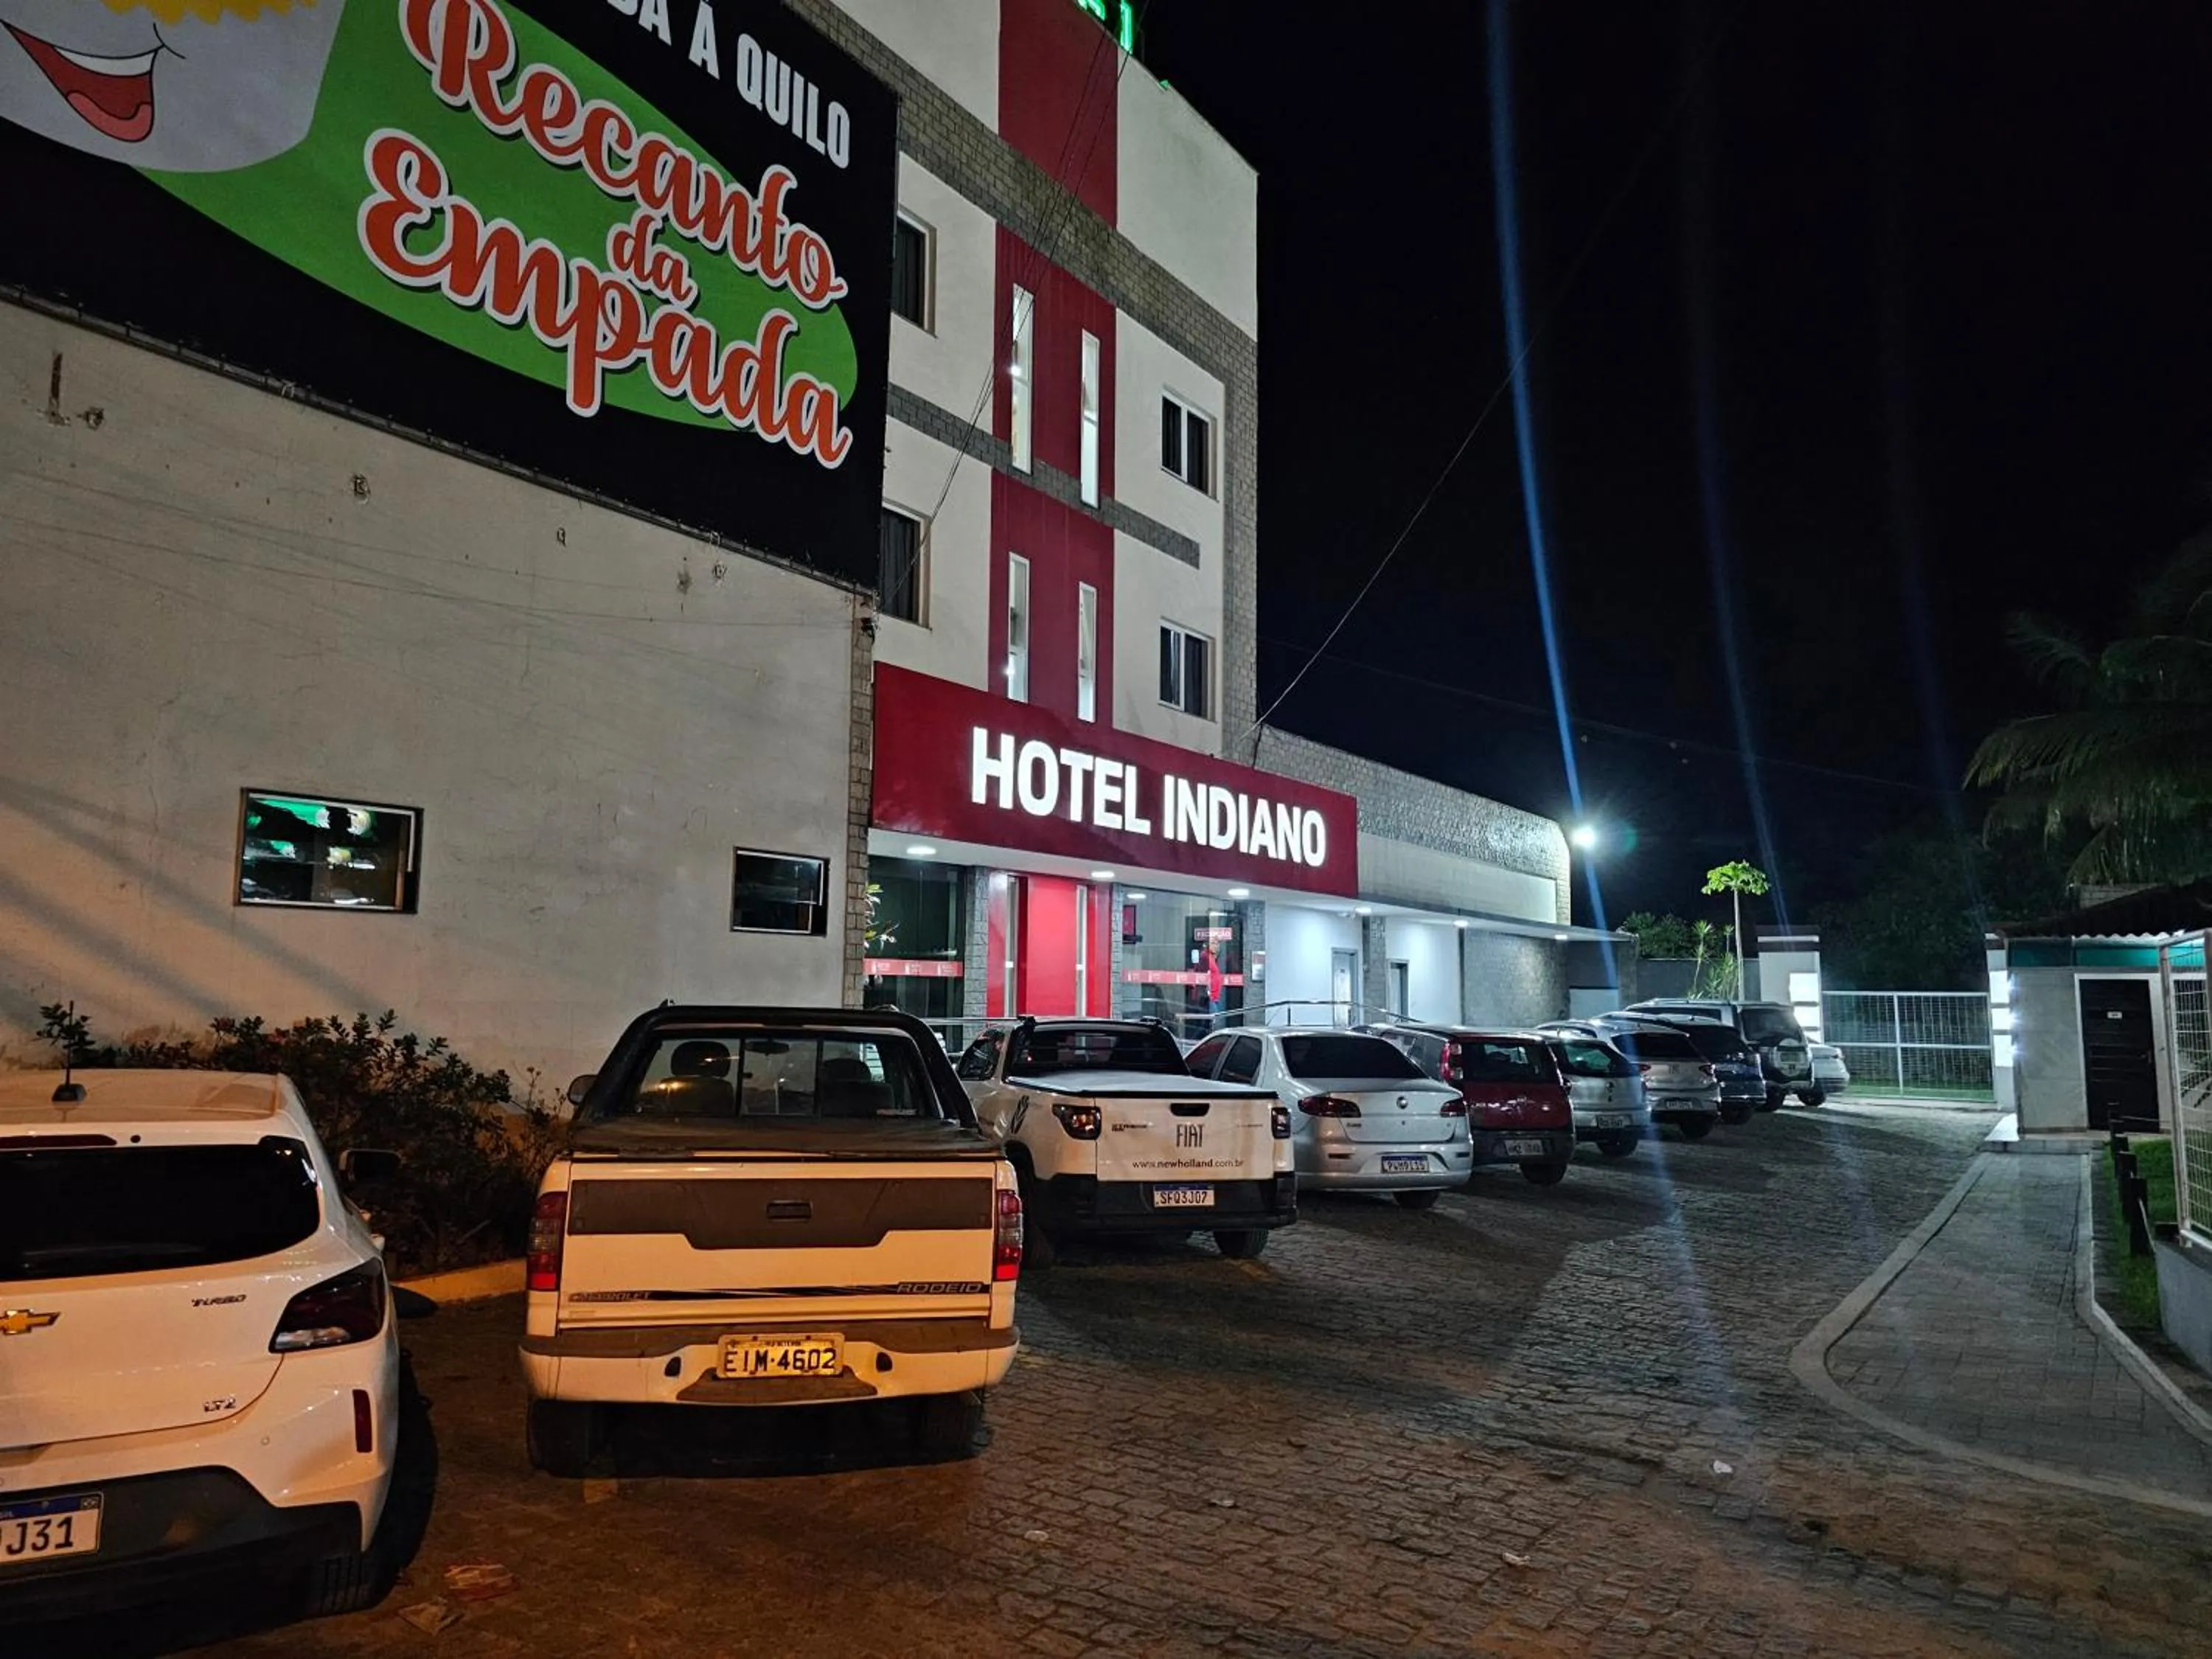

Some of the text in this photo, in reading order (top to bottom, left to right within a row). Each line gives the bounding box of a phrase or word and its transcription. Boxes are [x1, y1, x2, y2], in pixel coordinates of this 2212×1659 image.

[606, 0, 672, 46] A
[737, 33, 850, 169] QUILO
[399, 0, 847, 310] Recanto
[607, 211, 697, 307] da
[358, 128, 852, 469] Empada
[971, 726, 1327, 867] HOTEL INDIANO
[1175, 1124, 1205, 1147] FIAT
[1132, 1158, 1245, 1169] www.newholland.com.br
[1159, 1191, 1208, 1205] SFQ3J07
[192, 1295, 246, 1307] TURBO
[896, 1283, 982, 1293] RODEIO
[0, 1515, 74, 1556] J31
